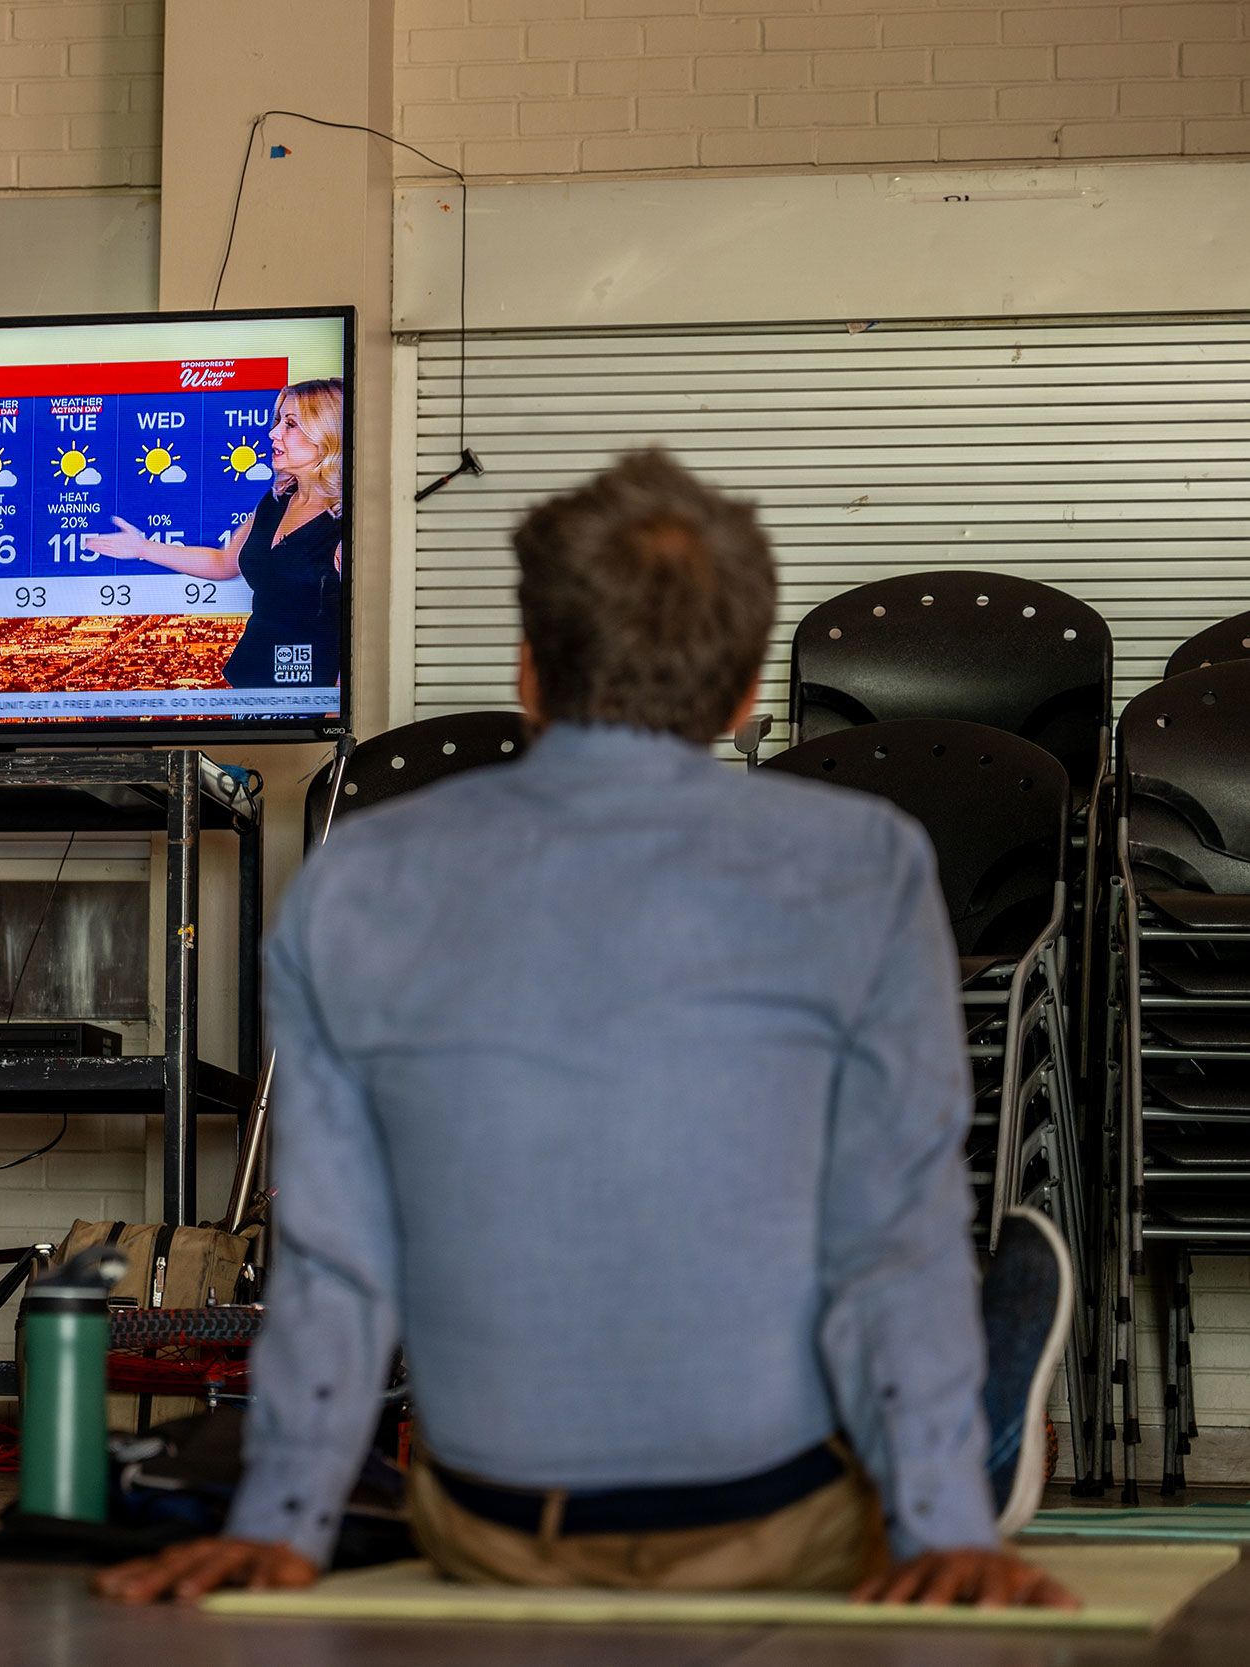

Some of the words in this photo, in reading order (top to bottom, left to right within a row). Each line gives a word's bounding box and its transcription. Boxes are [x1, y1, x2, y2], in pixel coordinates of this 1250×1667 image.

[51, 398, 103, 406] WEATHER
[56, 414, 96, 431] TUE
[138, 412, 185, 429] WED
[225, 410, 268, 426] THU
[60, 492, 89, 501] HEAT
[48, 503, 100, 513] WARNING
[61, 517, 88, 528] 20%
[148, 515, 171, 526] 10%
[48, 533, 101, 562] 115
[15, 587, 46, 607] 93
[100, 585, 131, 605] 93
[185, 583, 216, 603] 92
[295, 649, 310, 661] 15
[52, 701, 61, 709] A
[63, 699, 91, 709] FREE
[93, 699, 112, 709] AIR
[170, 698, 187, 707] GO
[191, 698, 206, 707] TO
